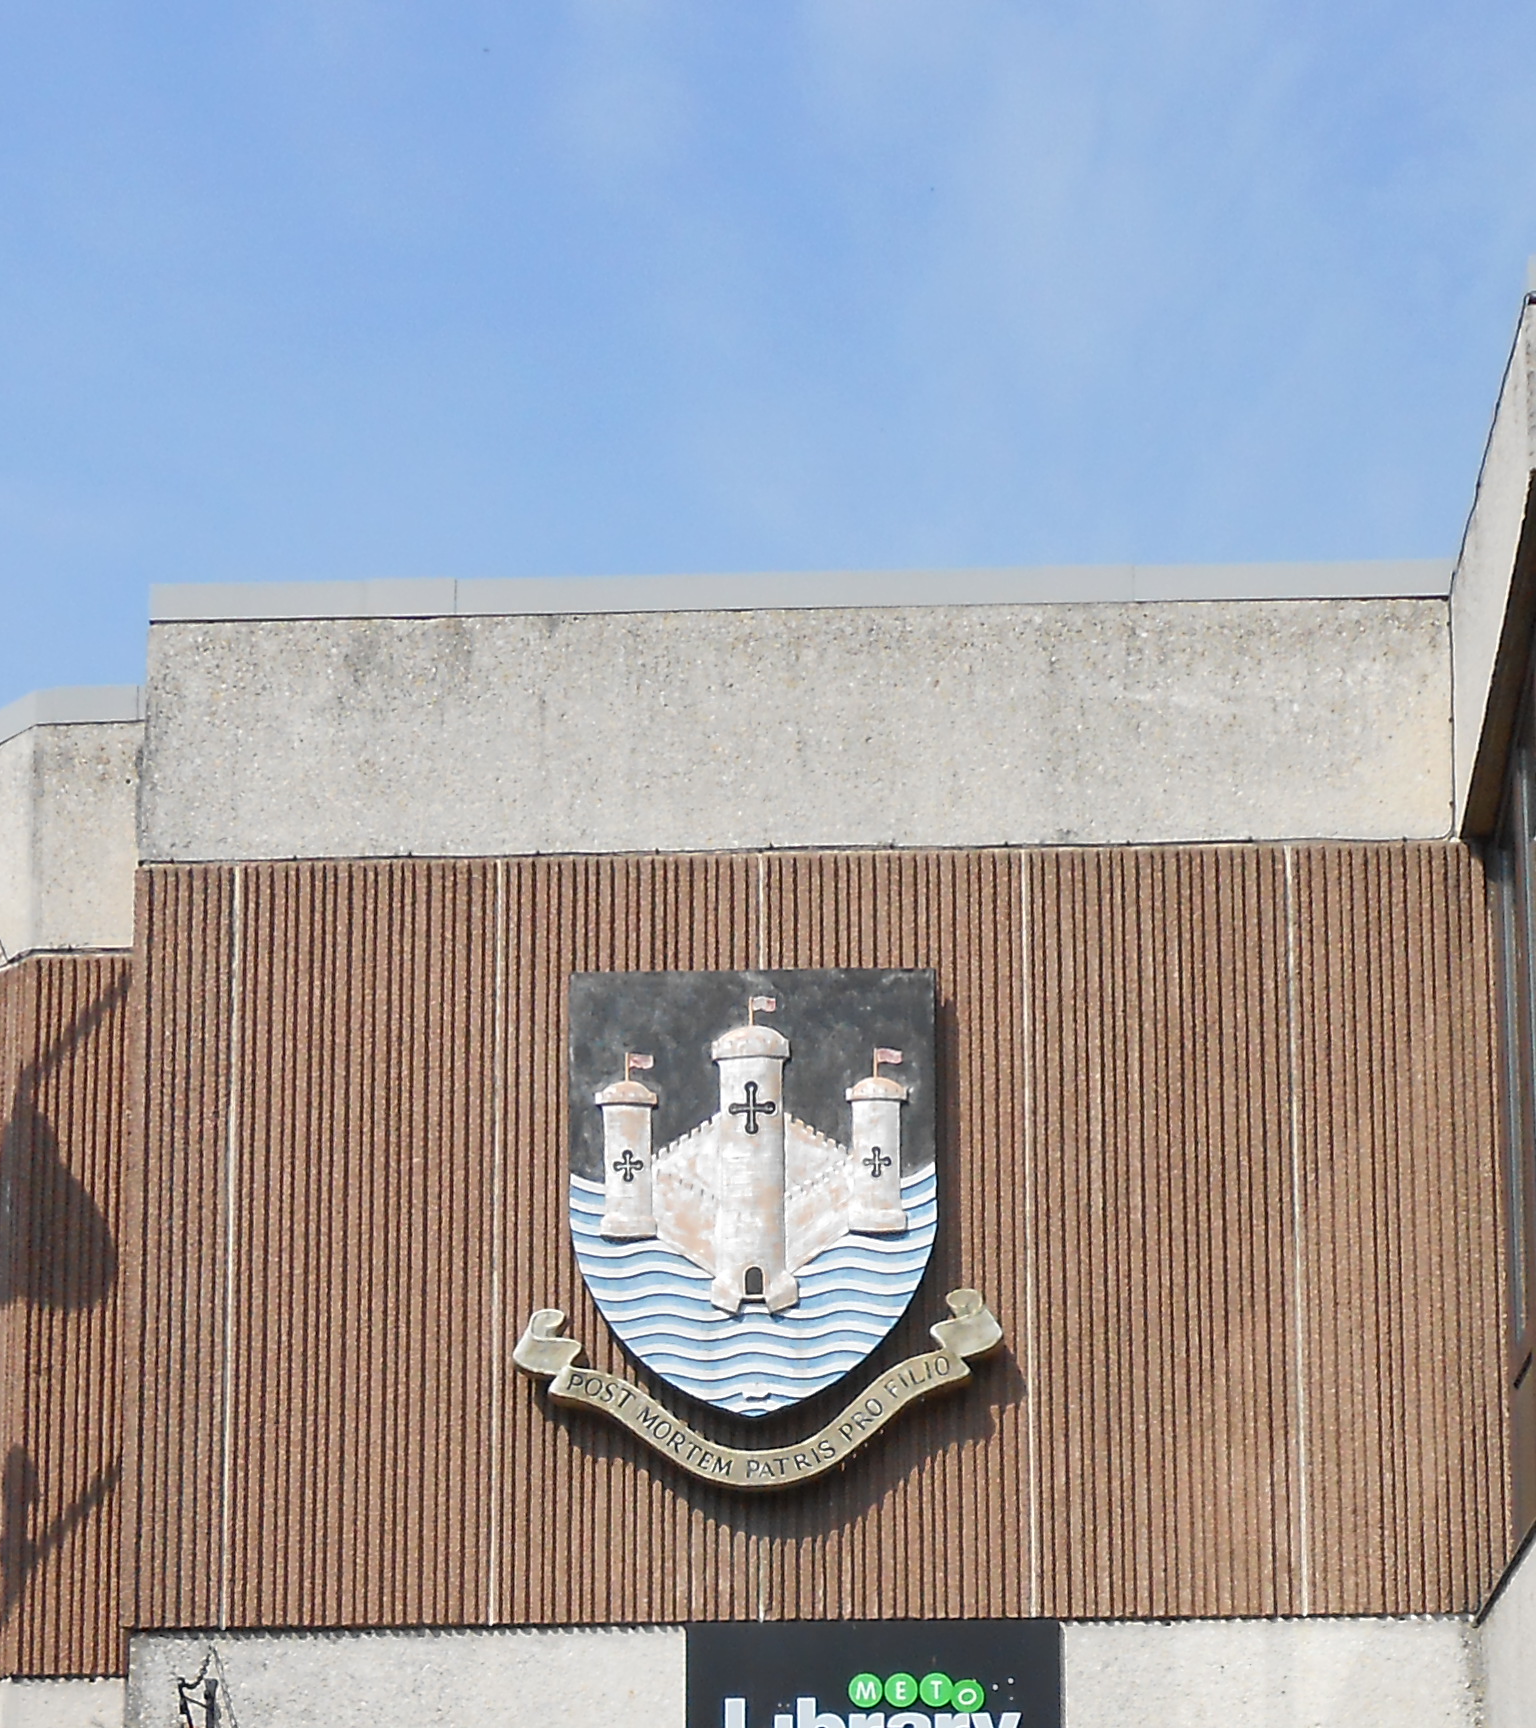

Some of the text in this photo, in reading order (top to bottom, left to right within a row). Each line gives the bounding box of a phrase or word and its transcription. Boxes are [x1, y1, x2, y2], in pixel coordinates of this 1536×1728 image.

[566, 1356, 951, 1479] POST MORTEM PATRIS PRO FILIO
